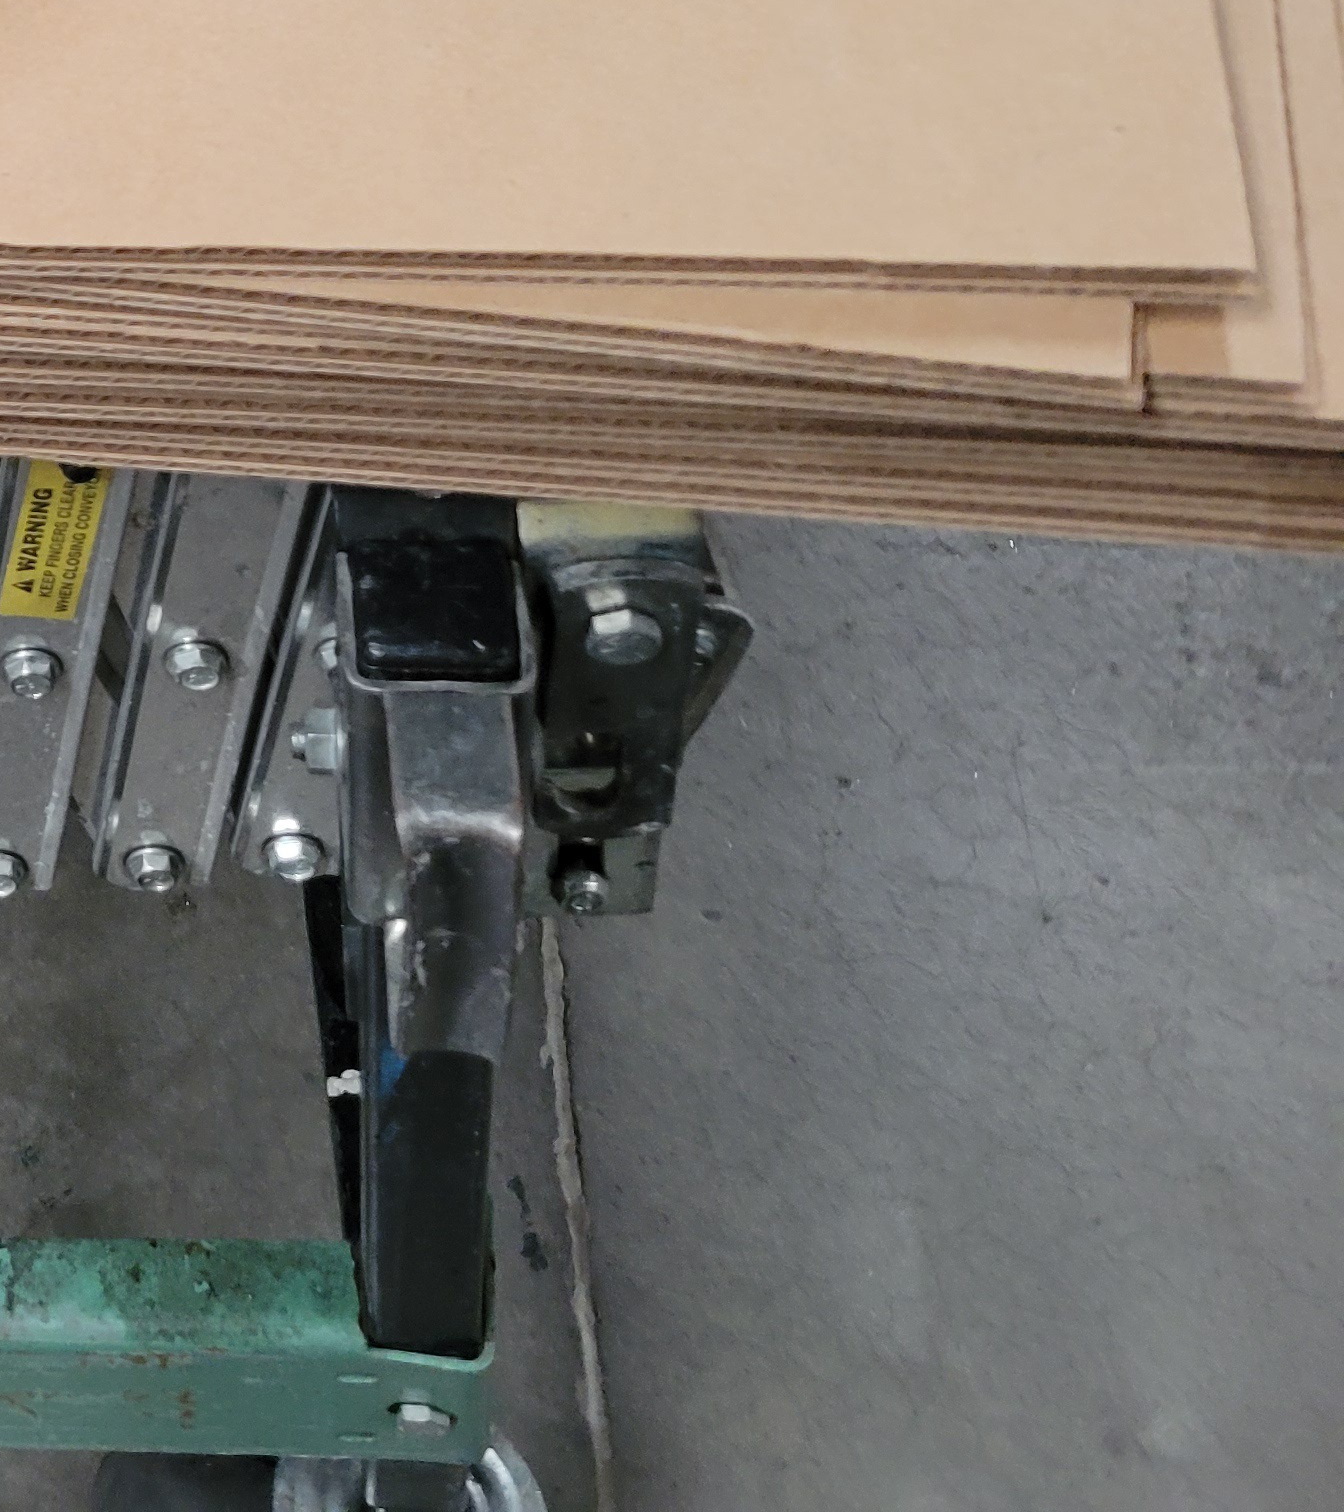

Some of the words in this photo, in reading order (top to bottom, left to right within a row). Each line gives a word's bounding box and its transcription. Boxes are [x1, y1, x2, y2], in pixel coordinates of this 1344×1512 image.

[75, 478, 100, 530] CONVEY
[16, 488, 53, 571] WARNING
[45, 521, 69, 567] FINGERS
[63, 533, 87, 580] CLOSING
[39, 570, 56, 597] KEEP
[55, 582, 74, 612] WHEN
